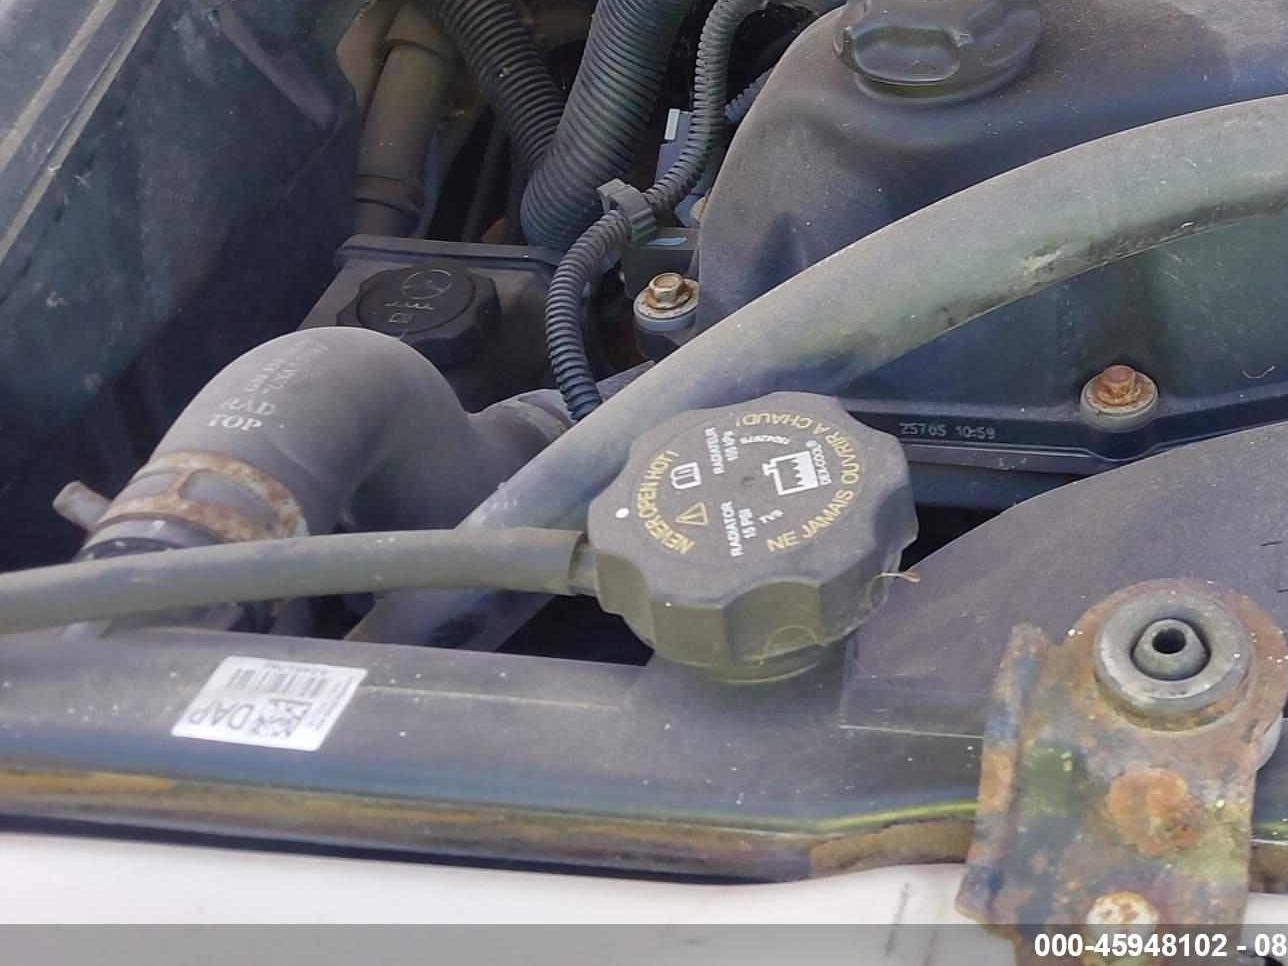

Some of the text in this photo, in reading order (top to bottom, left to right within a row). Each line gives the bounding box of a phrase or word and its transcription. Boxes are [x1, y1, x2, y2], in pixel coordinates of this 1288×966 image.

[208, 413, 263, 431] TOP
[735, 412, 815, 430] CHAUD!
[705, 426, 725, 475] RADIATEUR
[825, 430, 861, 486] OUVRIR
[636, 479, 658, 519] OPEN
[801, 489, 855, 540] JAMAIS
[644, 518, 696, 555] NEVER
[720, 500, 745, 558] RADIATOR
[766, 530, 800, 552] NE
[187, 700, 254, 731] DAP
